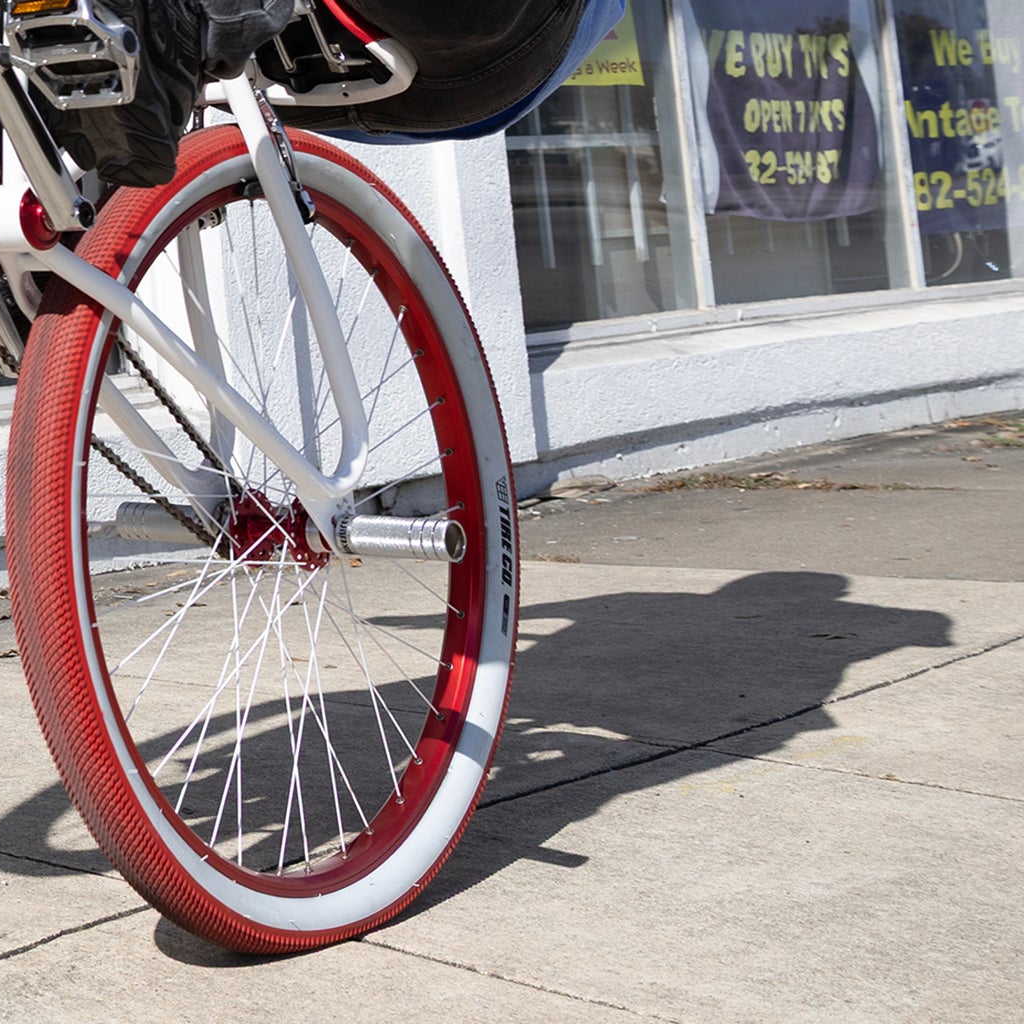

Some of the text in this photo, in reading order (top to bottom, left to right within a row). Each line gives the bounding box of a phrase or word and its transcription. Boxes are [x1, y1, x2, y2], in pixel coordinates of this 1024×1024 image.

[597, 57, 638, 74] Week
[929, 29, 974, 66] We
[744, 98, 793, 133] OPEN
[499, 505, 513, 553] TIRE
